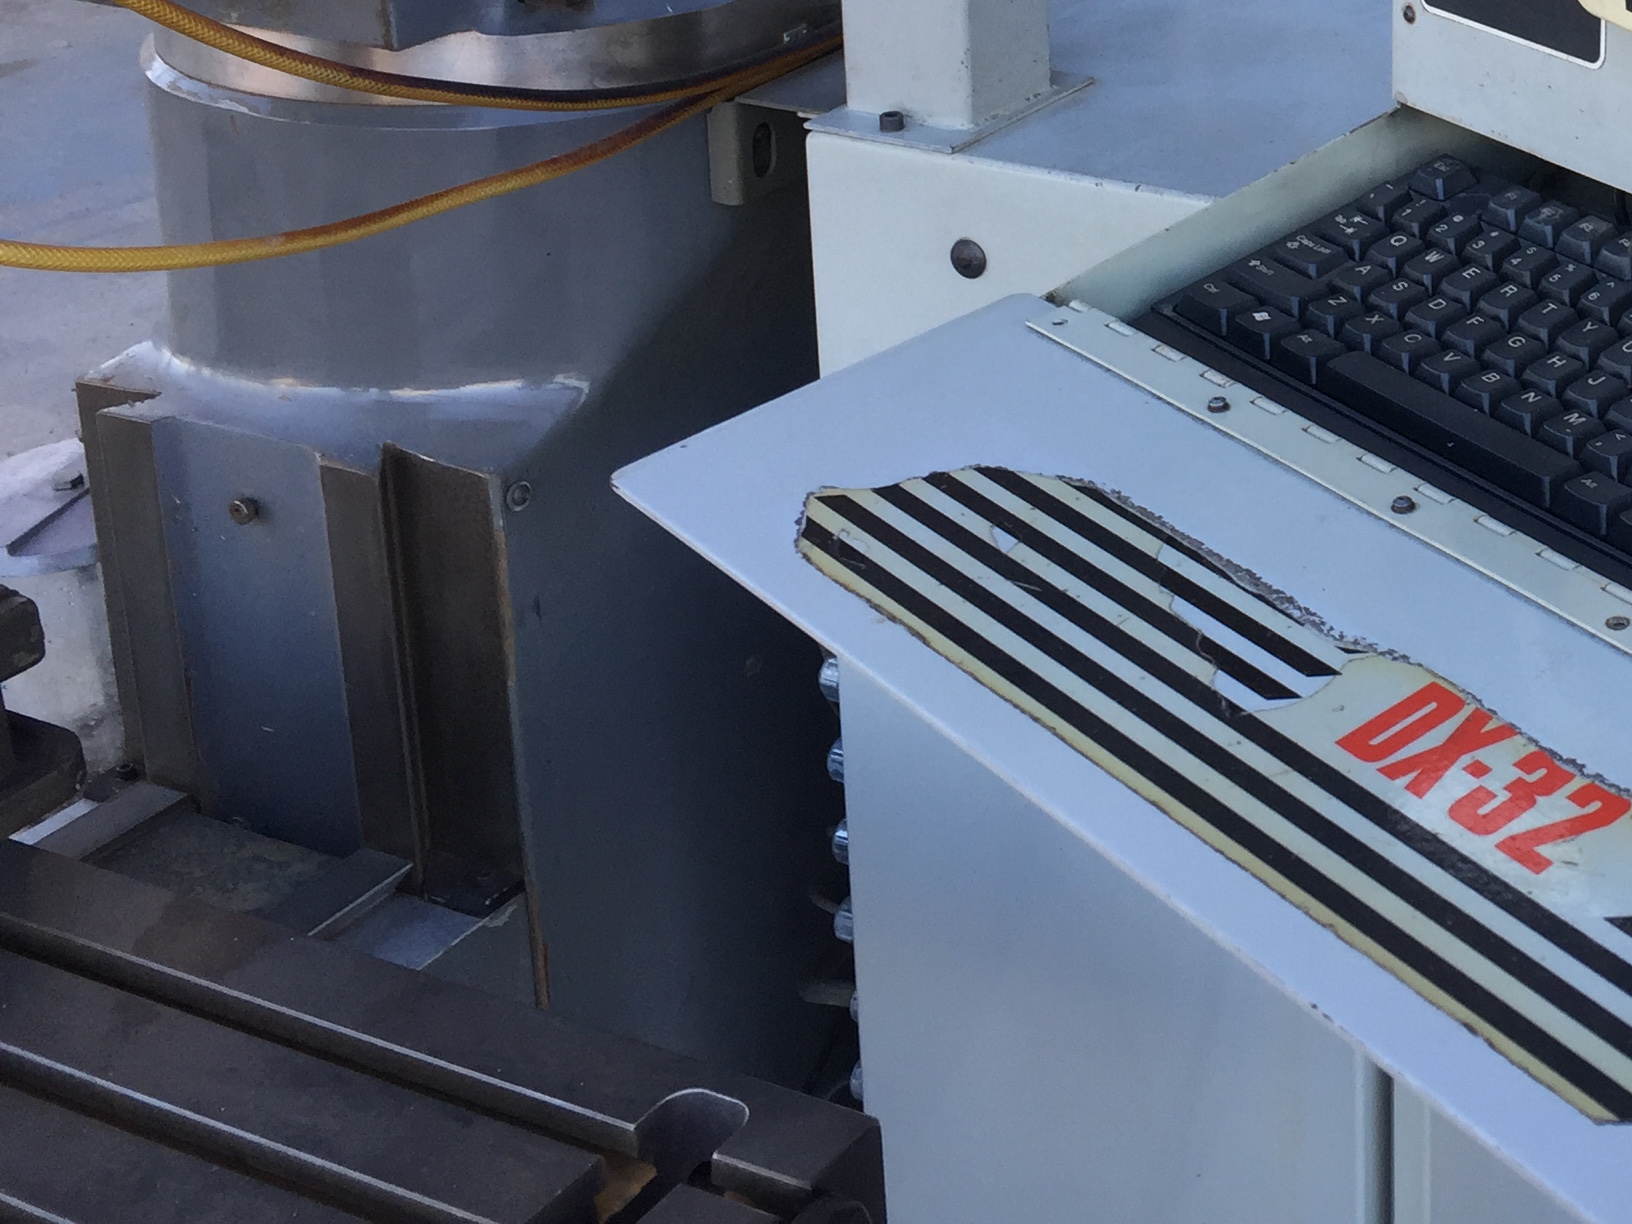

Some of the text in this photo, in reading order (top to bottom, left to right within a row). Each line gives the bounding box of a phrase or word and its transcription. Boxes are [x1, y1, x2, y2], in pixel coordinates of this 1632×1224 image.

[1435, 224, 1448, 233] 2
[1390, 236, 1407, 247] Q
[1472, 240, 1485, 249] 3
[1424, 250, 1445, 263] W
[1355, 265, 1372, 275] A
[1462, 267, 1481, 279] E
[1549, 274, 1561, 283] 5
[1392, 281, 1409, 291] S
[1500, 284, 1518, 297] R
[1327, 296, 1348, 306] Z
[1587, 291, 1600, 301] 6
[1427, 299, 1447, 310] D
[1542, 303, 1558, 314] T
[1364, 314, 1385, 324] X
[1466, 316, 1485, 325] F
[1582, 321, 1599, 332] Y
[1403, 333, 1422, 343] C
[1508, 336, 1526, 348] G
[1444, 352, 1461, 362] V
[1547, 356, 1567, 368] H
[1481, 372, 1500, 383] B
[1587, 376, 1606, 385] J
[1521, 392, 1542, 403] N
[1563, 413, 1587, 426] M
[1335, 681, 1632, 875] DX-32
